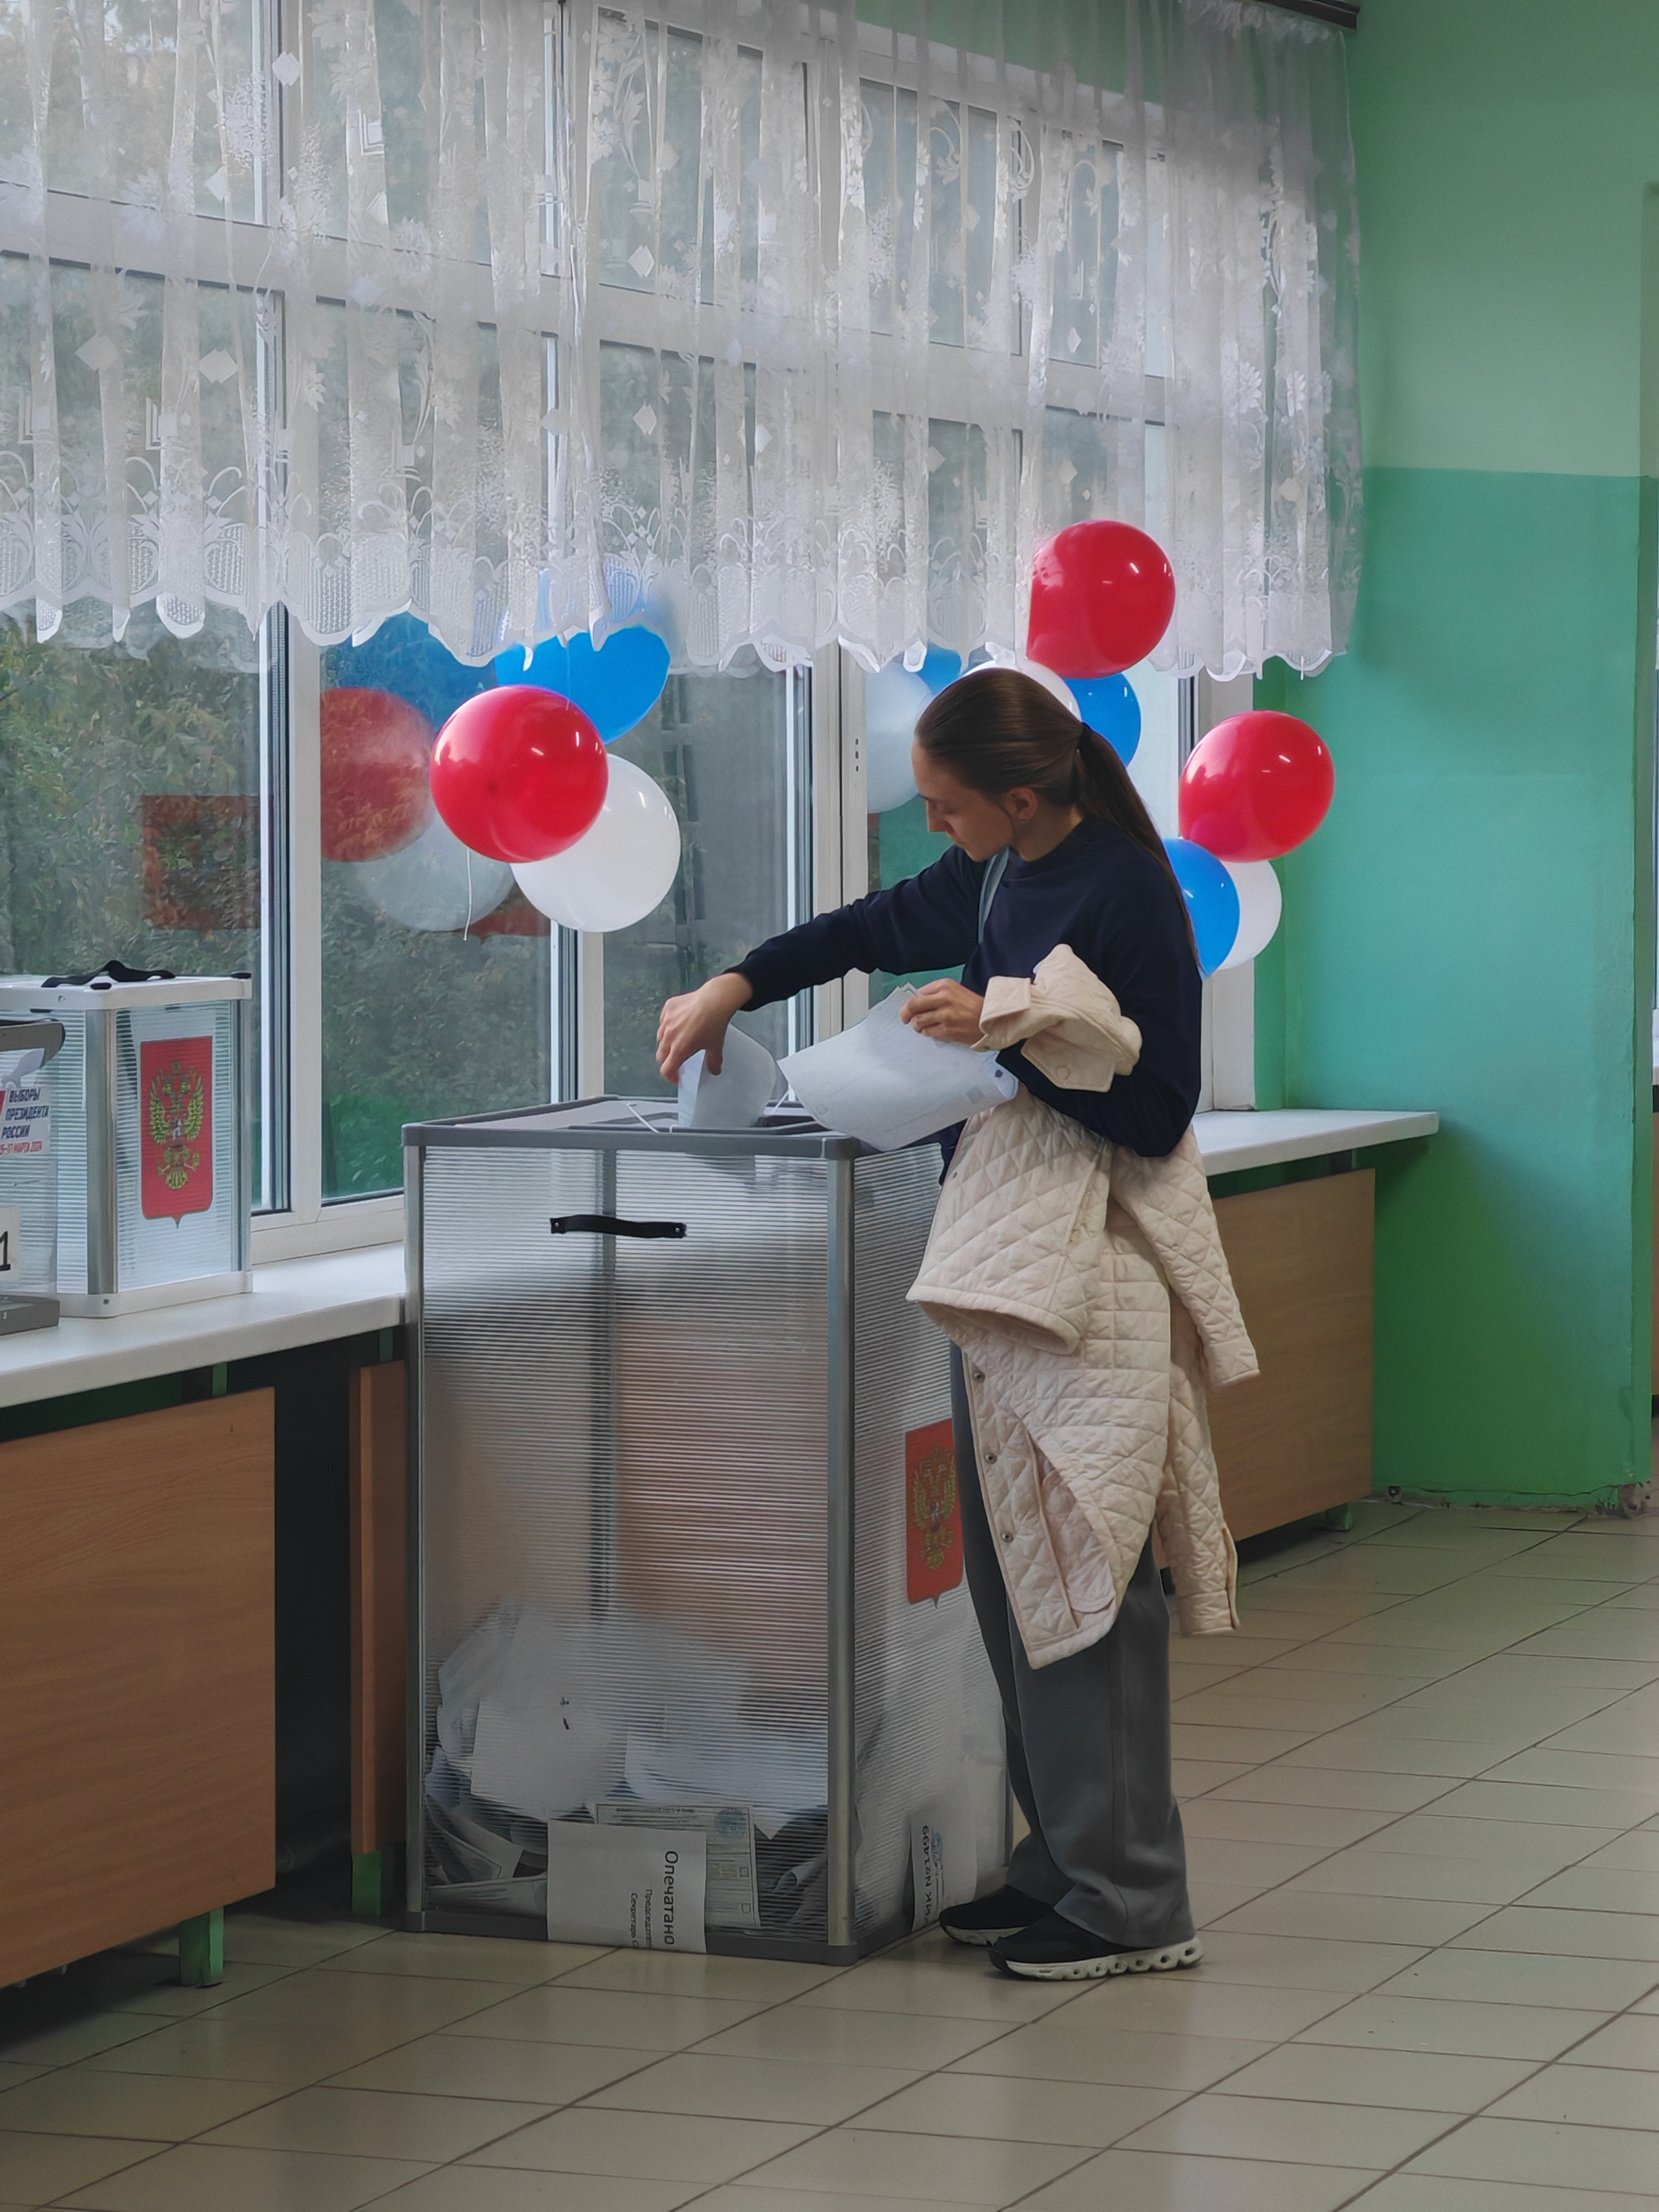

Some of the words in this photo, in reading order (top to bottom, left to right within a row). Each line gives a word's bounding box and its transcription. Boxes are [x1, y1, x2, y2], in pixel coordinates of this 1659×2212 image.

[9, 1088, 41, 1102] ВЫБОРЫ
[5, 1105, 50, 1121] ПРЕЗИДЕНТА
[1, 1124, 31, 1139] РОССИИ
[663, 1850, 678, 1945] Опечатано
